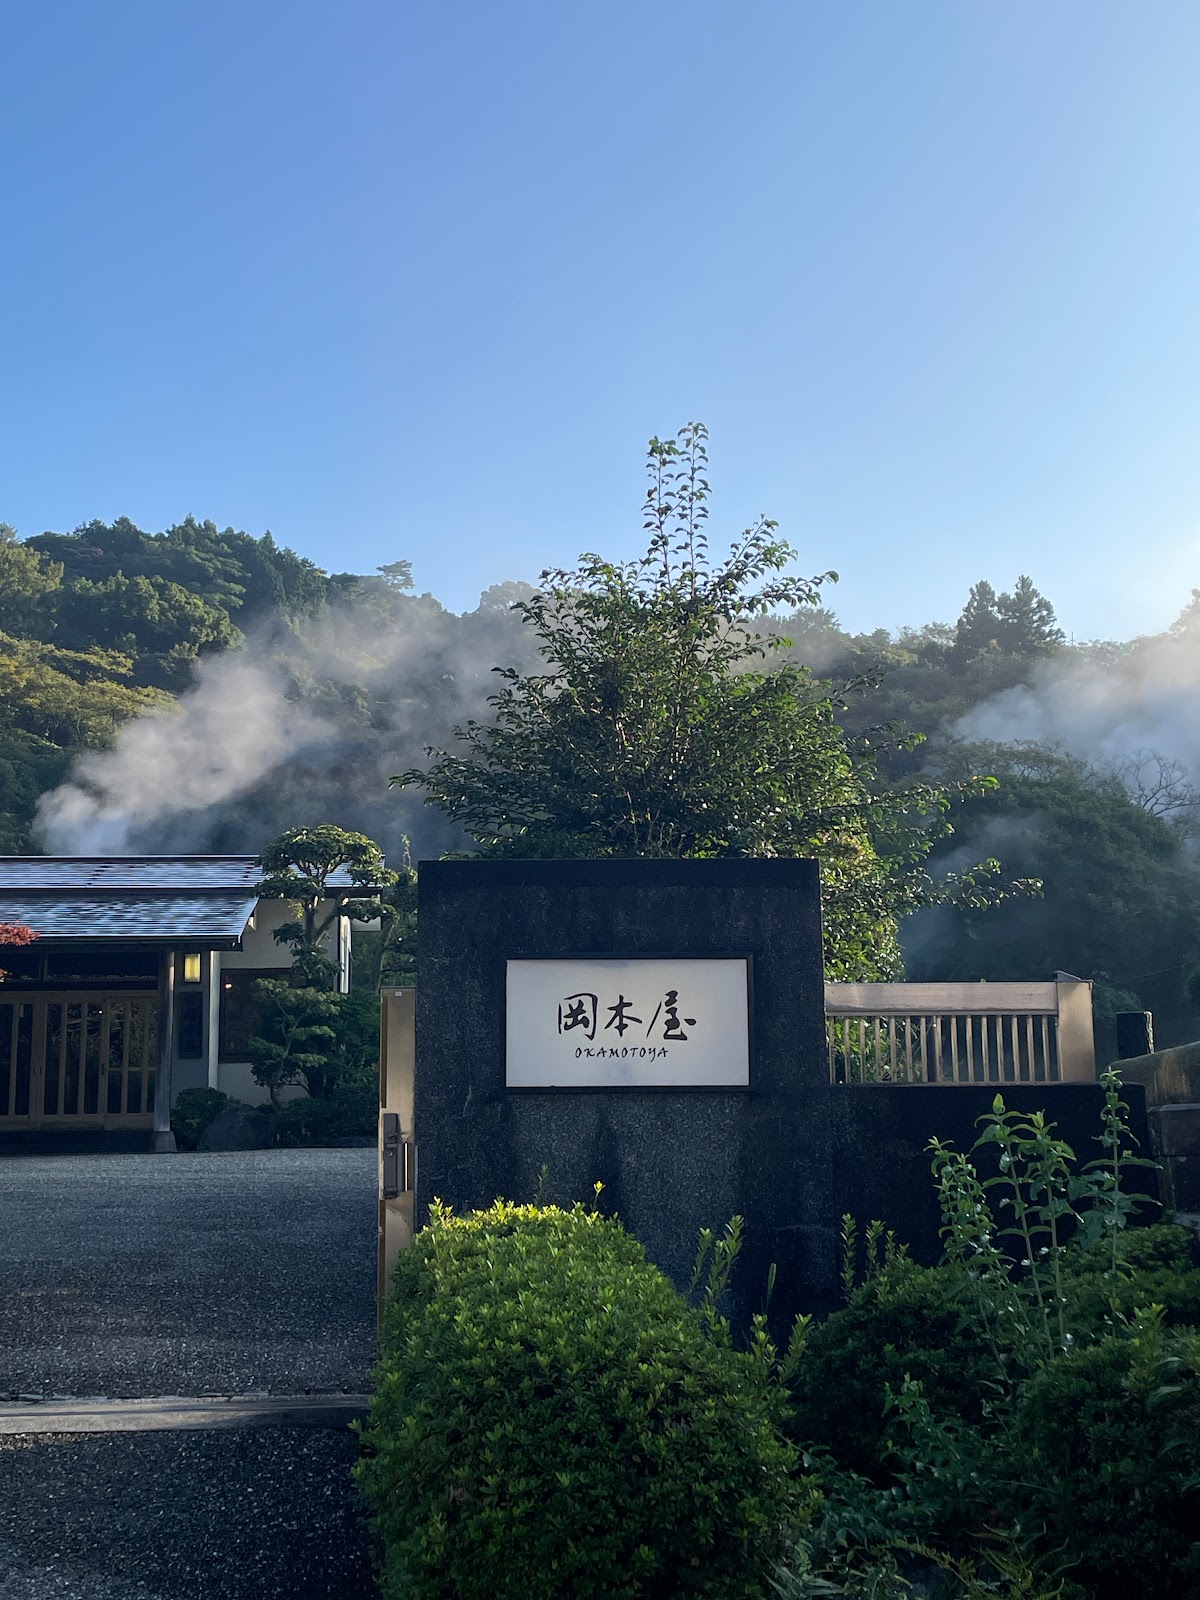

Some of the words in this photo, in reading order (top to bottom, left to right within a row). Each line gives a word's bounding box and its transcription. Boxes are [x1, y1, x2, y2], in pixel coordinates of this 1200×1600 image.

[557, 989, 697, 1042] 岡本屋
[574, 1046, 669, 1063] OKAMOTOYA
